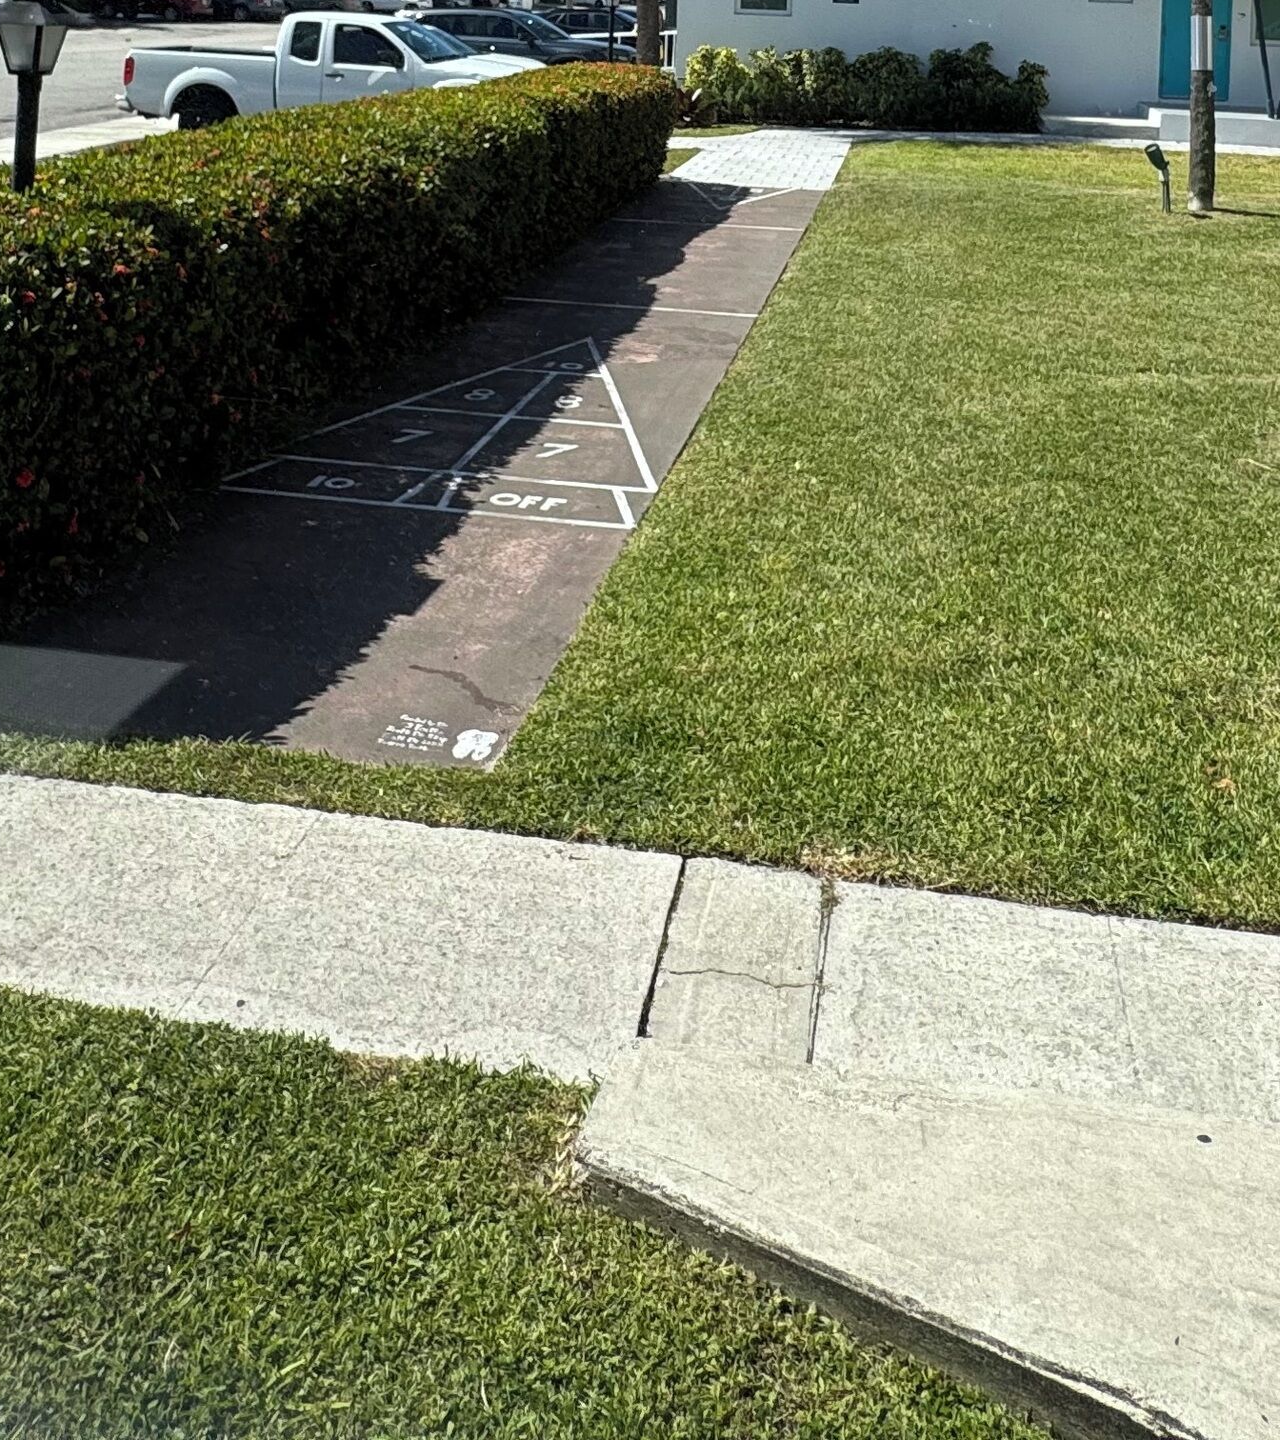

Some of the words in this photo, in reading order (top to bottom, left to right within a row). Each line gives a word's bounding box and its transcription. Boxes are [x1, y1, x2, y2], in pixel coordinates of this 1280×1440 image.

[464, 388, 496, 401] 8
[391, 428, 434, 444] 7
[536, 442, 579, 458] 7
[306, 475, 357, 490] 10
[489, 492, 568, 511] OFF
